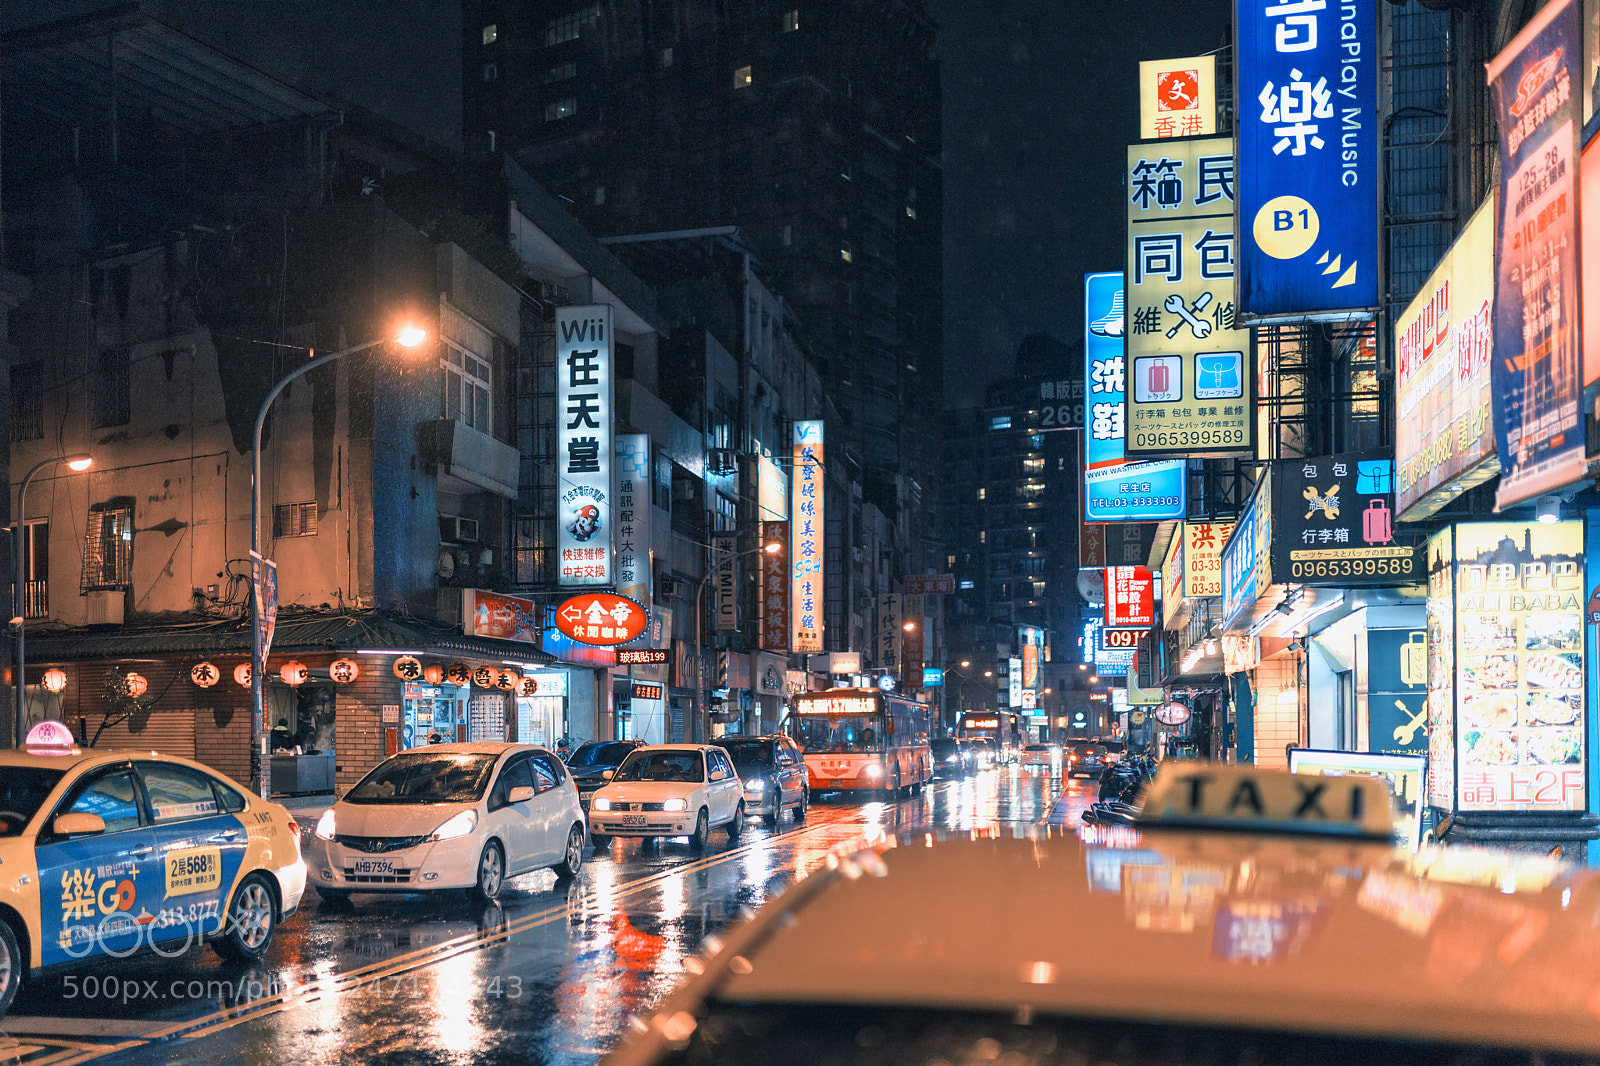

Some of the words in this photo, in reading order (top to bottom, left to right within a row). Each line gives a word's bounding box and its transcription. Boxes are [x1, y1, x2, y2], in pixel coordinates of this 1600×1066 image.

[1168, 79, 1192, 103] 文
[1154, 114, 1203, 138] 香港
[1341, 107, 1362, 187] Music
[1273, 208, 1310, 231] B1
[560, 318, 604, 343] Wii
[566, 349, 600, 474] 任天堂
[1136, 408, 1166, 420] 行李箱
[1172, 407, 1192, 418] 包包
[1198, 406, 1218, 417] 專業
[1224, 405, 1244, 416] 維修
[1136, 429, 1243, 447] 0965399589
[1120, 483, 1150, 493] 民生店
[1309, 497, 1339, 511] 維修
[620, 480, 634, 583] 通訊配件大批發
[1302, 528, 1349, 544] 行李箱
[563, 548, 605, 561] 快速維修
[563, 565, 605, 578] 中古交換
[1292, 559, 1413, 577] 0965399589
[1460, 561, 1580, 593] 阿里巴巴
[1461, 594, 1501, 612] ALI
[1510, 593, 1581, 611] BABA
[584, 600, 632, 626] 金帝
[619, 651, 666, 663] 玻璃貼199
[398, 661, 418, 677] 味
[449, 666, 469, 682] 味
[1463, 769, 1582, 804] 請上2F
[1177, 775, 1364, 819] TAXI
